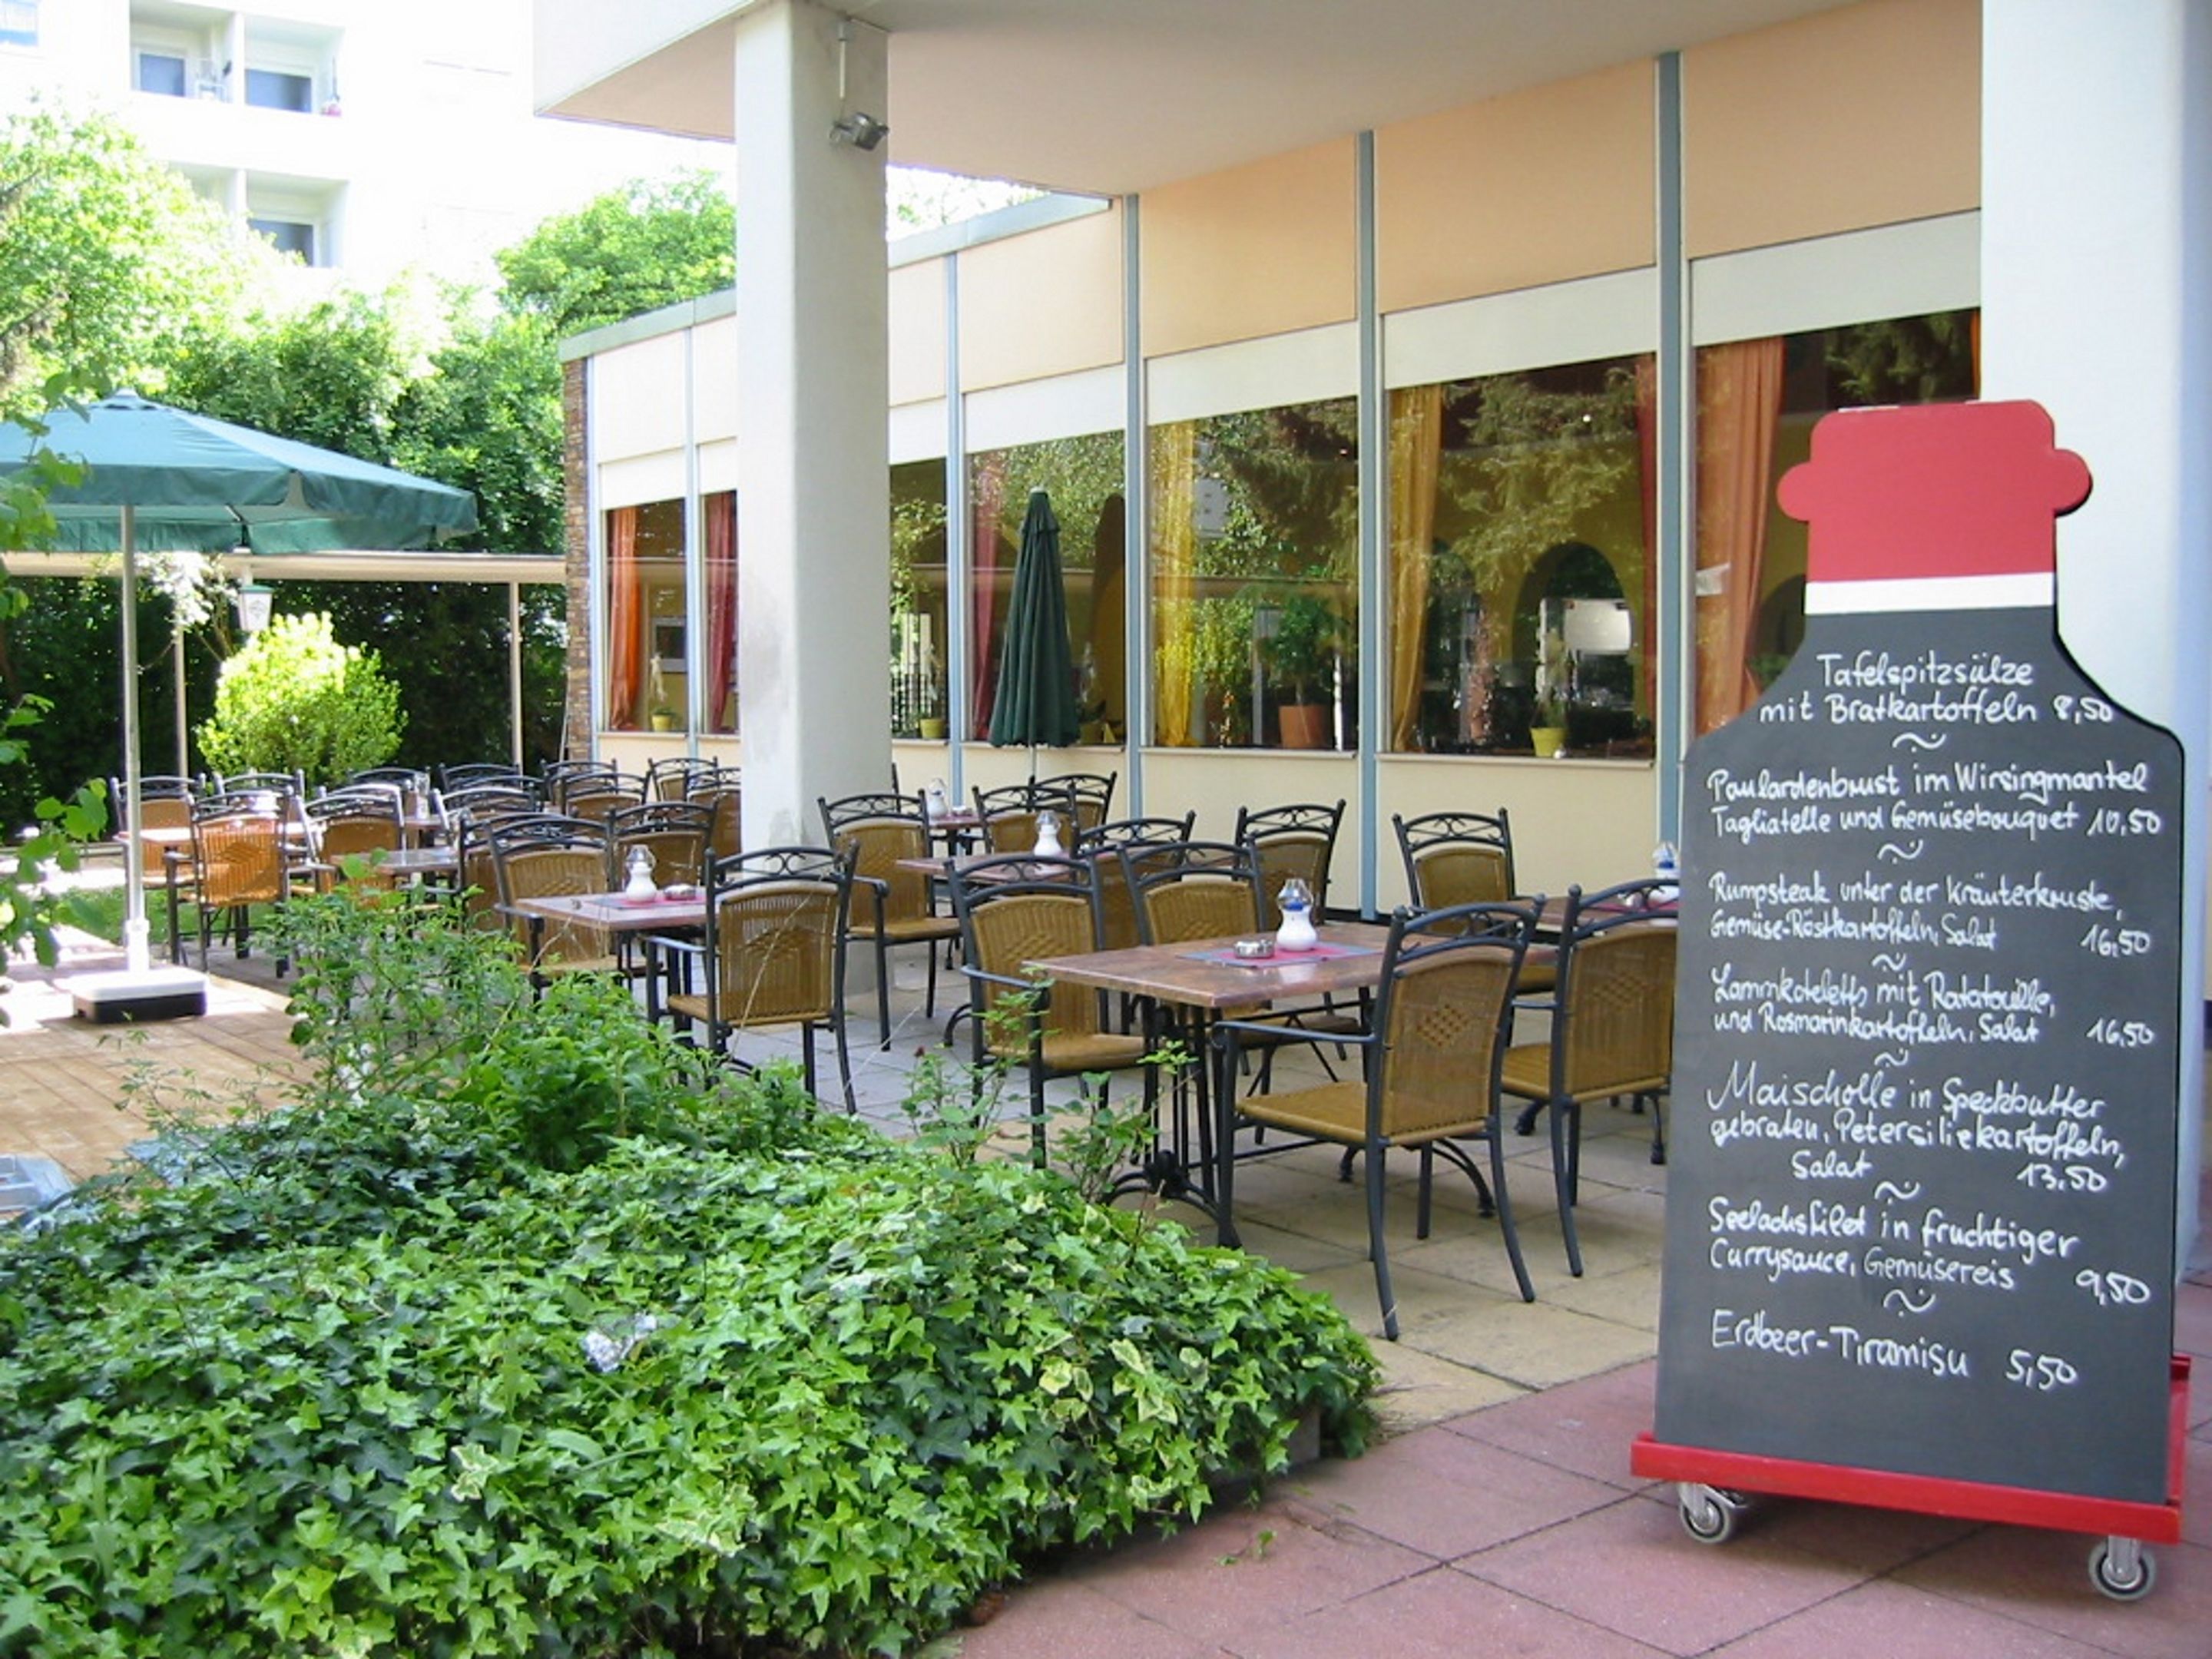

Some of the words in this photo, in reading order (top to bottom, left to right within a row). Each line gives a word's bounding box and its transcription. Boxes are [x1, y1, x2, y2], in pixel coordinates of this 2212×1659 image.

[1816, 650, 2034, 694] Tafelspitzsülze
[1760, 691, 1813, 724] mit
[1824, 686, 2038, 725] Bratkartoffeln
[2053, 695, 2114, 724] 8,50
[1912, 763, 1950, 793] im
[1954, 760, 2148, 805] Wirsingmantel
[1710, 805, 1831, 845] Tagliatelle
[1839, 806, 1884, 830] und
[1891, 800, 2079, 841] Gemüsebouquet
[2086, 807, 2162, 837] 10,50
[1708, 869, 1831, 910] Rumpsteak
[1839, 869, 1892, 902] unter
[1899, 880, 1939, 903] der
[1710, 906, 1939, 946] Gemüse-Röstkartoffeln,
[1940, 912, 1997, 951] Salat
[1711, 962, 1868, 1008] Lammkoteletts
[1876, 969, 1920, 1006] mit
[1923, 970, 2056, 1018] Ratatouille,
[1714, 1008, 1753, 1033] und
[1757, 1000, 1974, 1045] Rosmarinkartoffeln,
[1979, 1012, 2040, 1042] Salat
[1707, 1060, 1897, 1111] Maischolle
[1908, 1078, 1933, 1109] in
[1943, 1076, 2106, 1122] Speckbutter
[1710, 1108, 1830, 1147] gebraten,
[1833, 1107, 2125, 1170] Petersiliekartoffeln,
[1791, 1149, 1873, 1180] Salat
[1709, 1196, 1866, 1237] Seelachsfilet
[1880, 1210, 1910, 1240] in
[1922, 1207, 2080, 1264] fruchtiger
[1710, 1237, 1856, 1283] Currysauce,
[1863, 1246, 2015, 1290] Gemüsereis
[2075, 1270, 2151, 1306] 9,50
[1711, 1309, 1971, 1378] Erdbeer-Tiramisu
[2005, 1349, 2078, 1391] 5,50
